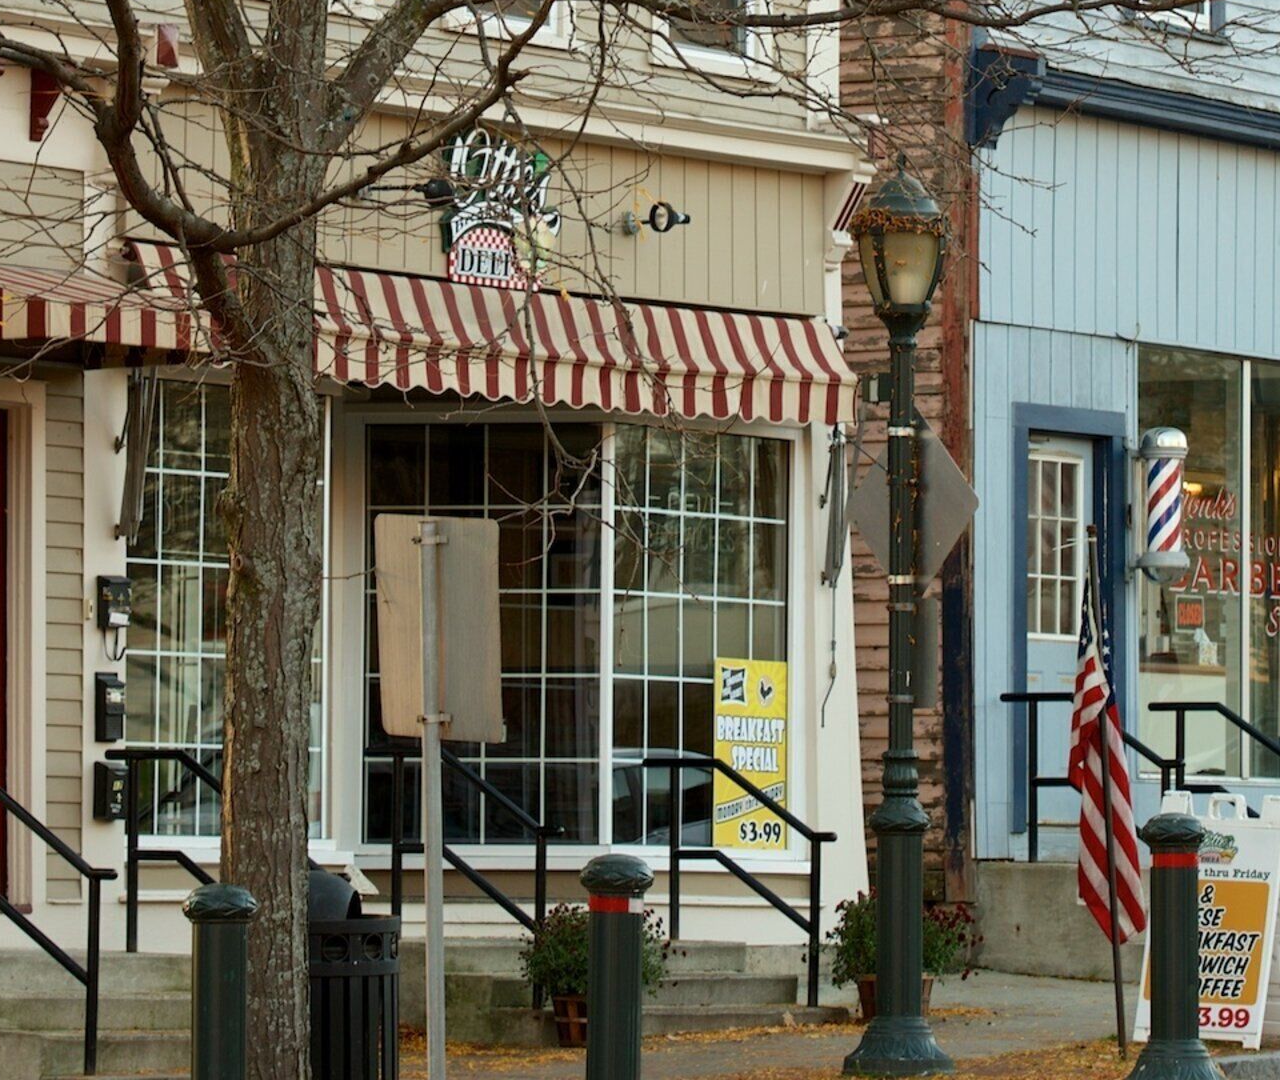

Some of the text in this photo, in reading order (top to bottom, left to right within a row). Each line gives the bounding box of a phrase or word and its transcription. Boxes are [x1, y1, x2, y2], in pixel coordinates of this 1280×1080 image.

[460, 248, 510, 277] DELI
[715, 715, 785, 744] BREAKFAST
[730, 744, 779, 772] SPECIAL
[740, 822, 781, 843] $3.99
[1204, 867, 1271, 881] thru Friday
[1198, 1007, 1251, 1029] 3.99
